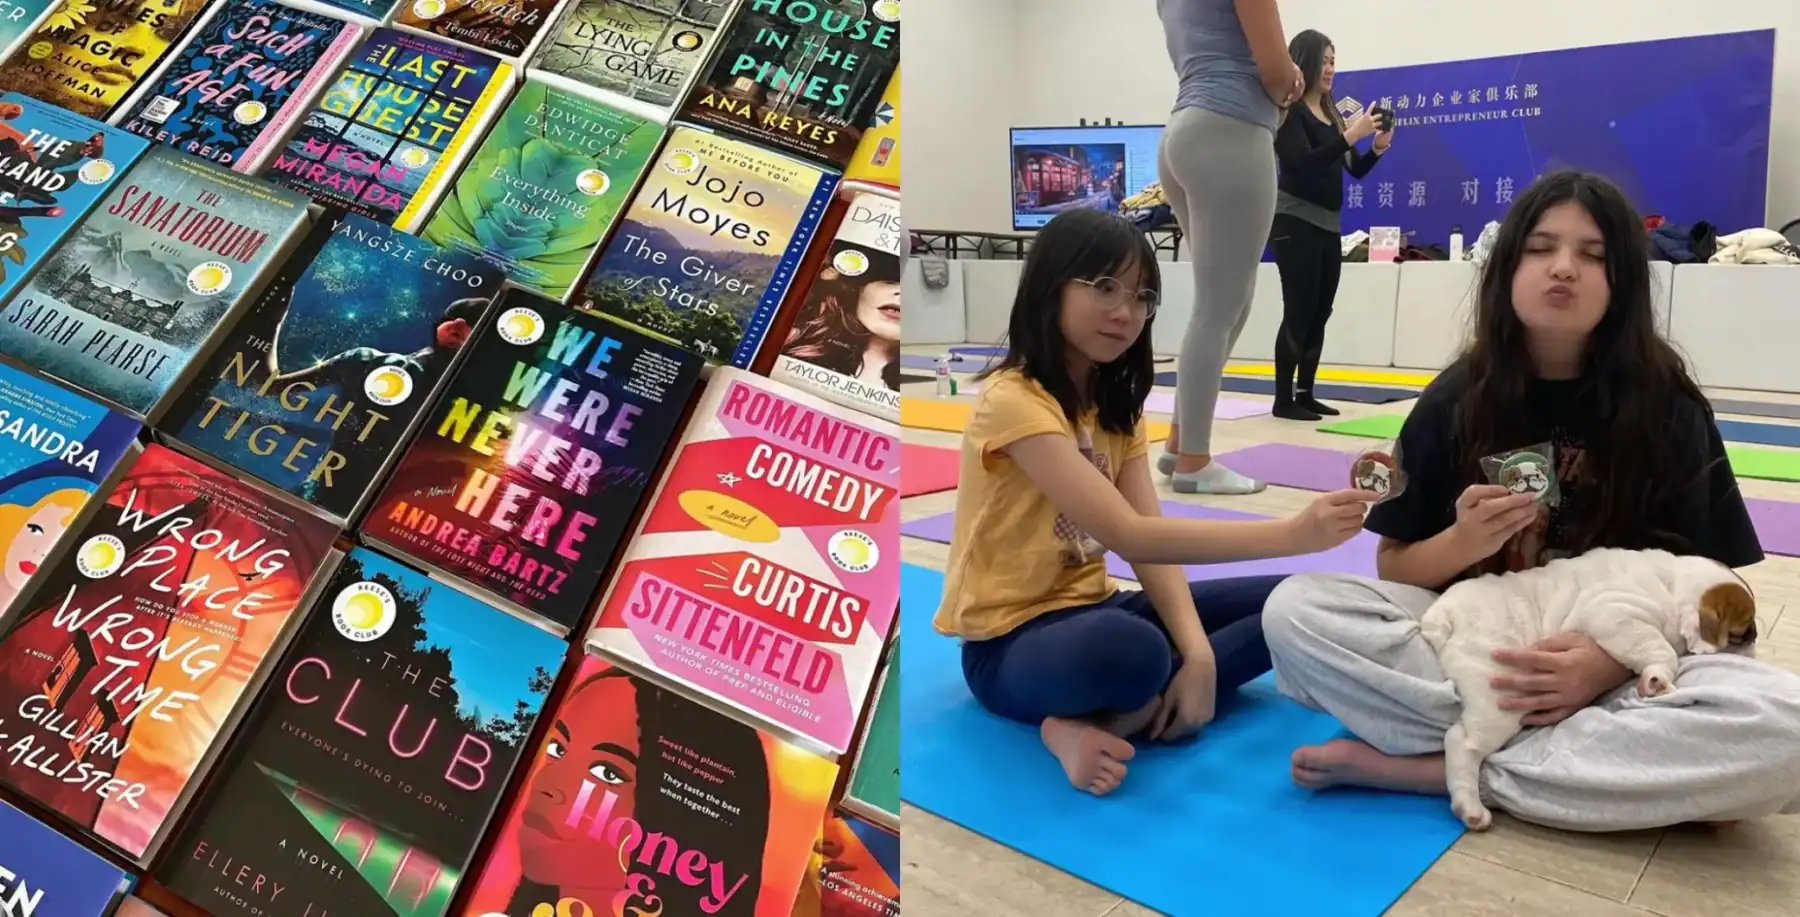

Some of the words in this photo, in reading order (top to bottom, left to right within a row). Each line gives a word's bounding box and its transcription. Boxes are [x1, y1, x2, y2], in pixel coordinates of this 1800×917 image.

[49, 25, 145, 67] MAGIC
[444, 20, 479, 40] Tembi
[484, 33, 519, 51] Locke
[574, 21, 653, 58] LYING
[606, 16, 636, 33] THE
[751, 0, 896, 49] HOUSE
[51, 52, 104, 76] ALICE
[365, 43, 388, 64] THE
[379, 45, 477, 89] LAST
[604, 53, 686, 88] GAME
[754, 27, 790, 50] IN
[803, 38, 860, 72] THE
[20, 60, 107, 98] HOFFMAN
[171, 69, 251, 107] AGE
[338, 69, 465, 123] HOUSE
[729, 53, 850, 107] PINES
[320, 91, 455, 146] GUEST
[523, 114, 629, 160] DANTICAT
[536, 102, 633, 146] EDWIDGE
[699, 93, 752, 119] ANA
[762, 110, 839, 145] REYES
[1423, 108, 1509, 125] ENTREPRENEUR
[1511, 107, 1542, 119] CLUB
[20, 128, 72, 159] THE
[125, 119, 182, 145] KILEY
[187, 141, 234, 163] REID
[303, 135, 409, 184] MEGAN
[708, 142, 755, 164] Bestselling
[0, 153, 66, 192] LAND
[272, 153, 402, 211] MIRANDA
[686, 164, 765, 208] Jojo
[698, 147, 714, 158] ME
[719, 153, 761, 174] BEFORE
[766, 169, 790, 185] YOU
[195, 189, 223, 208] THE
[351, 206, 378, 220] GIRLS
[489, 166, 593, 219] Everything
[502, 191, 558, 224] Inside
[107, 184, 269, 265] SANATORIUM
[650, 187, 771, 248] Moyes
[330, 218, 416, 263] YANGSZE
[423, 257, 484, 289] CHOO
[622, 233, 668, 265] The
[680, 256, 756, 297] Giver
[616, 275, 653, 291] of
[652, 276, 720, 318] Stars
[8, 298, 84, 347] SARAH
[81, 328, 171, 383] PEARSE
[245, 334, 273, 353] THE
[546, 320, 624, 381] WE
[784, 358, 840, 389] TAYLOR
[219, 351, 391, 443] NIGHT
[502, 360, 644, 448] WERE
[198, 395, 347, 488] TIGER
[436, 396, 603, 496] NEVER
[722, 382, 891, 472] ROMANTIC
[745, 443, 885, 521] COMEDY
[116, 487, 291, 580] WRONG
[454, 467, 598, 562] HERE
[720, 508, 758, 530] novel
[388, 500, 483, 558] ANDREA
[487, 544, 568, 595] BARTZ
[389, 524, 418, 544] AUTHOR
[430, 543, 448, 557] THE
[448, 550, 465, 566] LOST
[465, 557, 491, 577] NIGHT
[489, 570, 507, 585] AND
[508, 577, 526, 593] THE
[830, 551, 849, 570] BOOK
[848, 563, 869, 572] CLUB
[843, 531, 874, 547] REESE'S
[120, 545, 274, 620] PLACE
[134, 597, 153, 608] HOW
[153, 603, 165, 611] DO
[357, 584, 392, 605] REESE'S
[731, 556, 861, 640] CURTIS
[52, 583, 221, 682] WRONG
[136, 605, 156, 616] AFTER
[334, 612, 352, 635] BOOK
[353, 629, 379, 639] CLUB
[31, 651, 55, 663] NOVEL
[630, 578, 834, 695] SITTENFELD
[90, 655, 200, 727] TIME
[380, 650, 449, 699] THE
[653, 634, 679, 651] NEW
[677, 642, 710, 663] YORK
[709, 654, 741, 678] TIMES
[742, 672, 811, 708] BESTSELLING
[659, 649, 703, 672] AUTHOR
[704, 666, 721, 679] OF
[749, 686, 775, 704] AND
[774, 697, 823, 725] ELIGIBLE
[18, 693, 131, 760] GILLIAN
[285, 656, 493, 792] CLUB
[0, 731, 146, 809] ALLISTER
[280, 720, 350, 763] EVERYONE'S
[353, 758, 392, 785] DYING
[398, 780, 413, 795] TO
[657, 734, 683, 753] Sweet
[684, 746, 700, 760] like
[699, 755, 737, 779] plantain,
[661, 750, 676, 763] hot
[677, 757, 694, 771] like
[692, 766, 725, 785] pepper
[660, 786, 683, 802] when
[663, 771, 683, 789] They
[683, 782, 705, 798] taste
[705, 793, 721, 806] the
[721, 800, 742, 816] best
[278, 838, 288, 849] A
[297, 847, 345, 881] NOVEL
[564, 778, 750, 914] Honey
[191, 840, 286, 903] ELLERY
[213, 885, 249, 910] AUTHOR
[250, 906, 265, 917] OF
[611, 872, 664, 917] &
[842, 889, 885, 913] ANGELES
